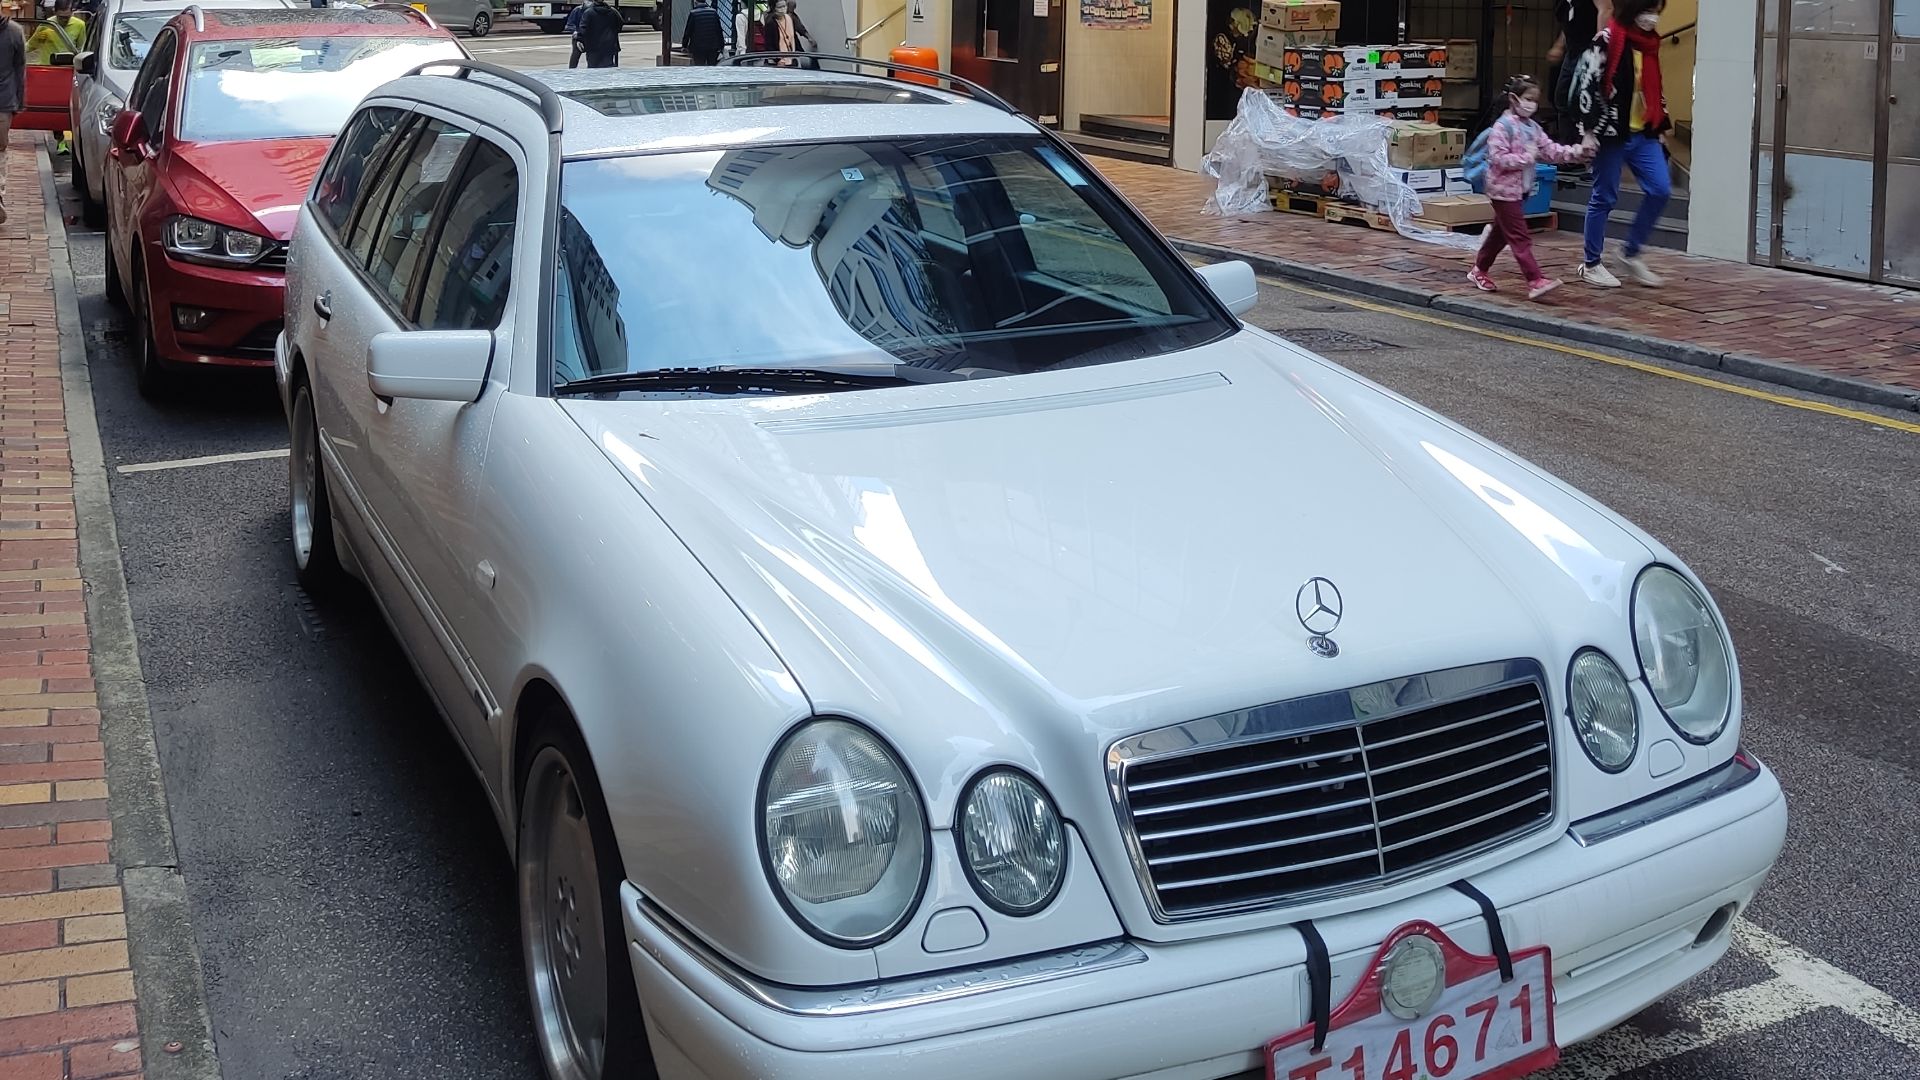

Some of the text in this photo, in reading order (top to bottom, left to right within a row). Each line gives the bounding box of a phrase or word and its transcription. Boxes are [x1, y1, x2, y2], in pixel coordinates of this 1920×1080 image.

[1302, 52, 1320, 61] Sunkist
[1404, 52, 1425, 60] Sunkist
[1301, 82, 1319, 91] Sunkist
[1399, 81, 1421, 89] Sunkist
[1396, 110, 1418, 118] Sunkist
